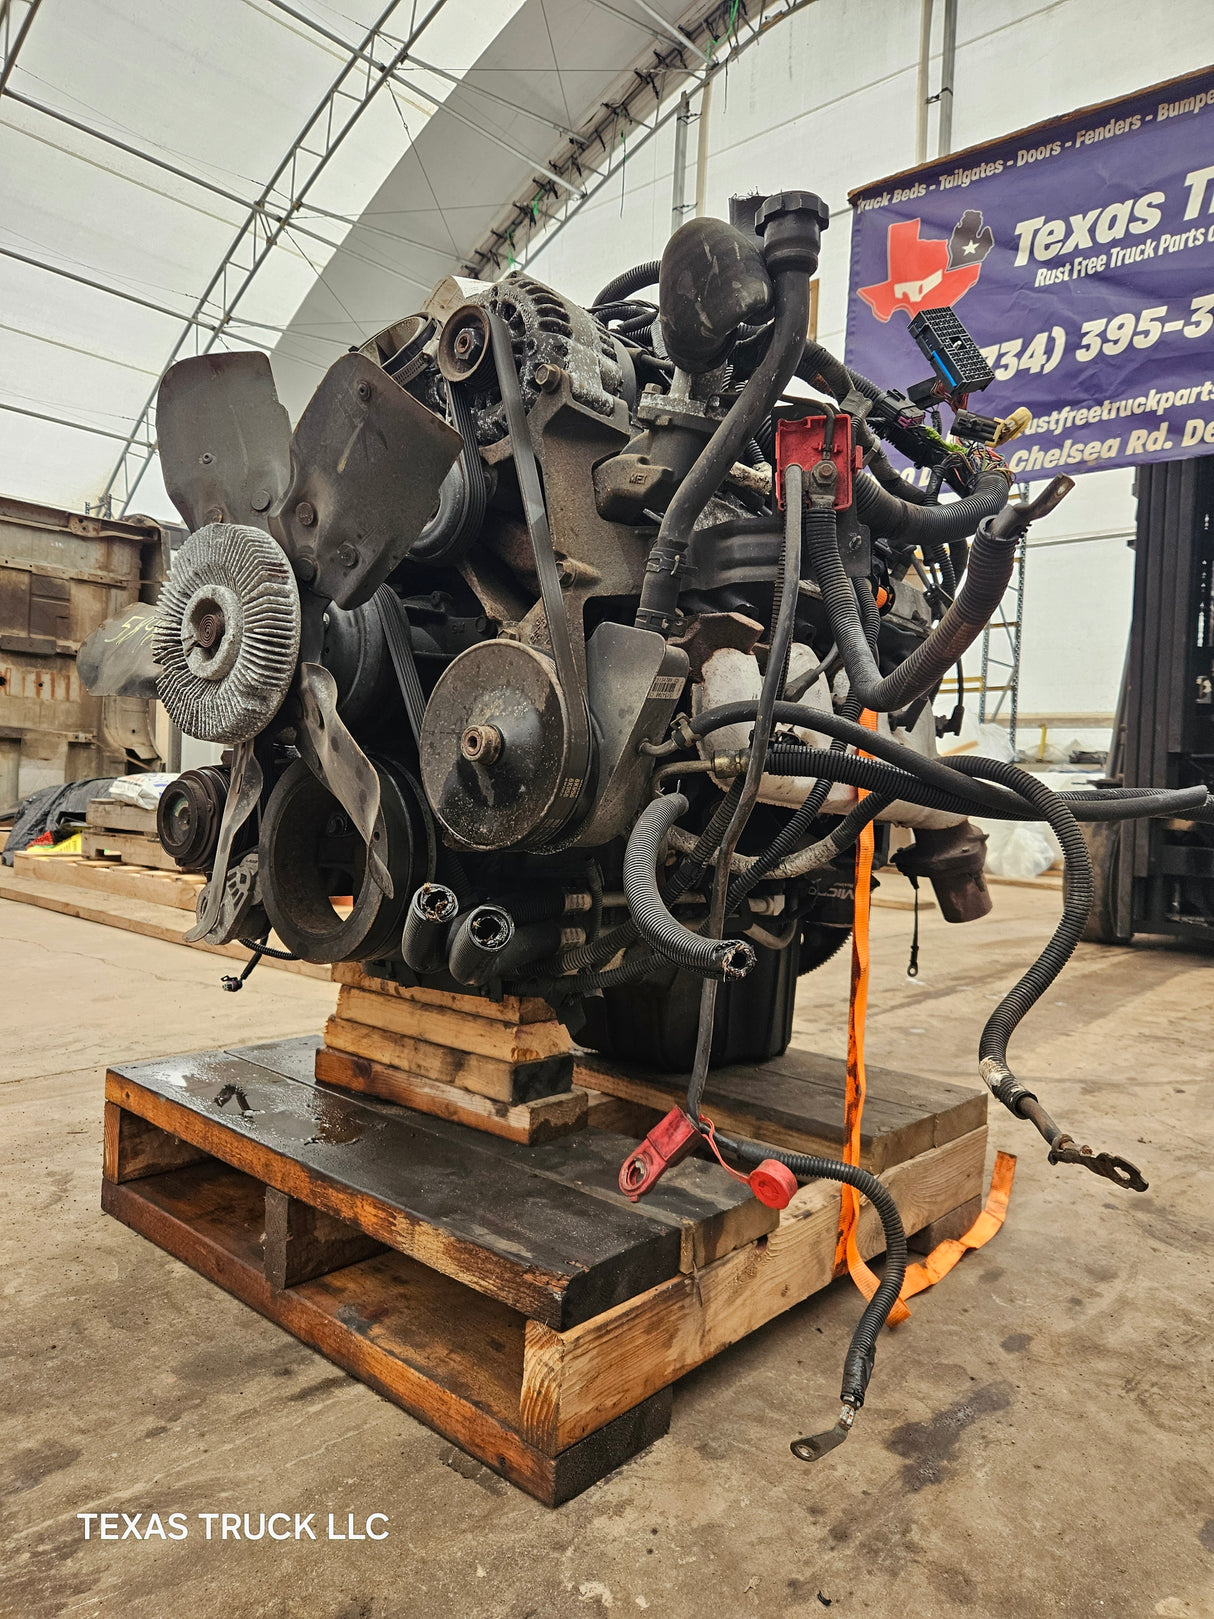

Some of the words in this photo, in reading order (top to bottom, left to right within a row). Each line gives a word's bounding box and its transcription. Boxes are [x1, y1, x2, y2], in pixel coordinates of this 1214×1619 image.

[892, 182, 926, 204] Beds
[939, 159, 1003, 191] Tailgates
[1017, 141, 1061, 167] Doors
[1075, 114, 1142, 148] Fenders
[1014, 191, 1166, 267] Texas
[1034, 262, 1072, 287] Rust
[1072, 254, 1108, 280] Free
[1110, 238, 1157, 268] Truck
[1158, 226, 1206, 256] Parts
[1075, 293, 1214, 362] 395-3
[1024, 381, 1214, 436] ustfreetruckpart
[1009, 435, 1118, 473] Chelsea
[1124, 421, 1173, 455] Rd.
[1181, 418, 1214, 447] De
